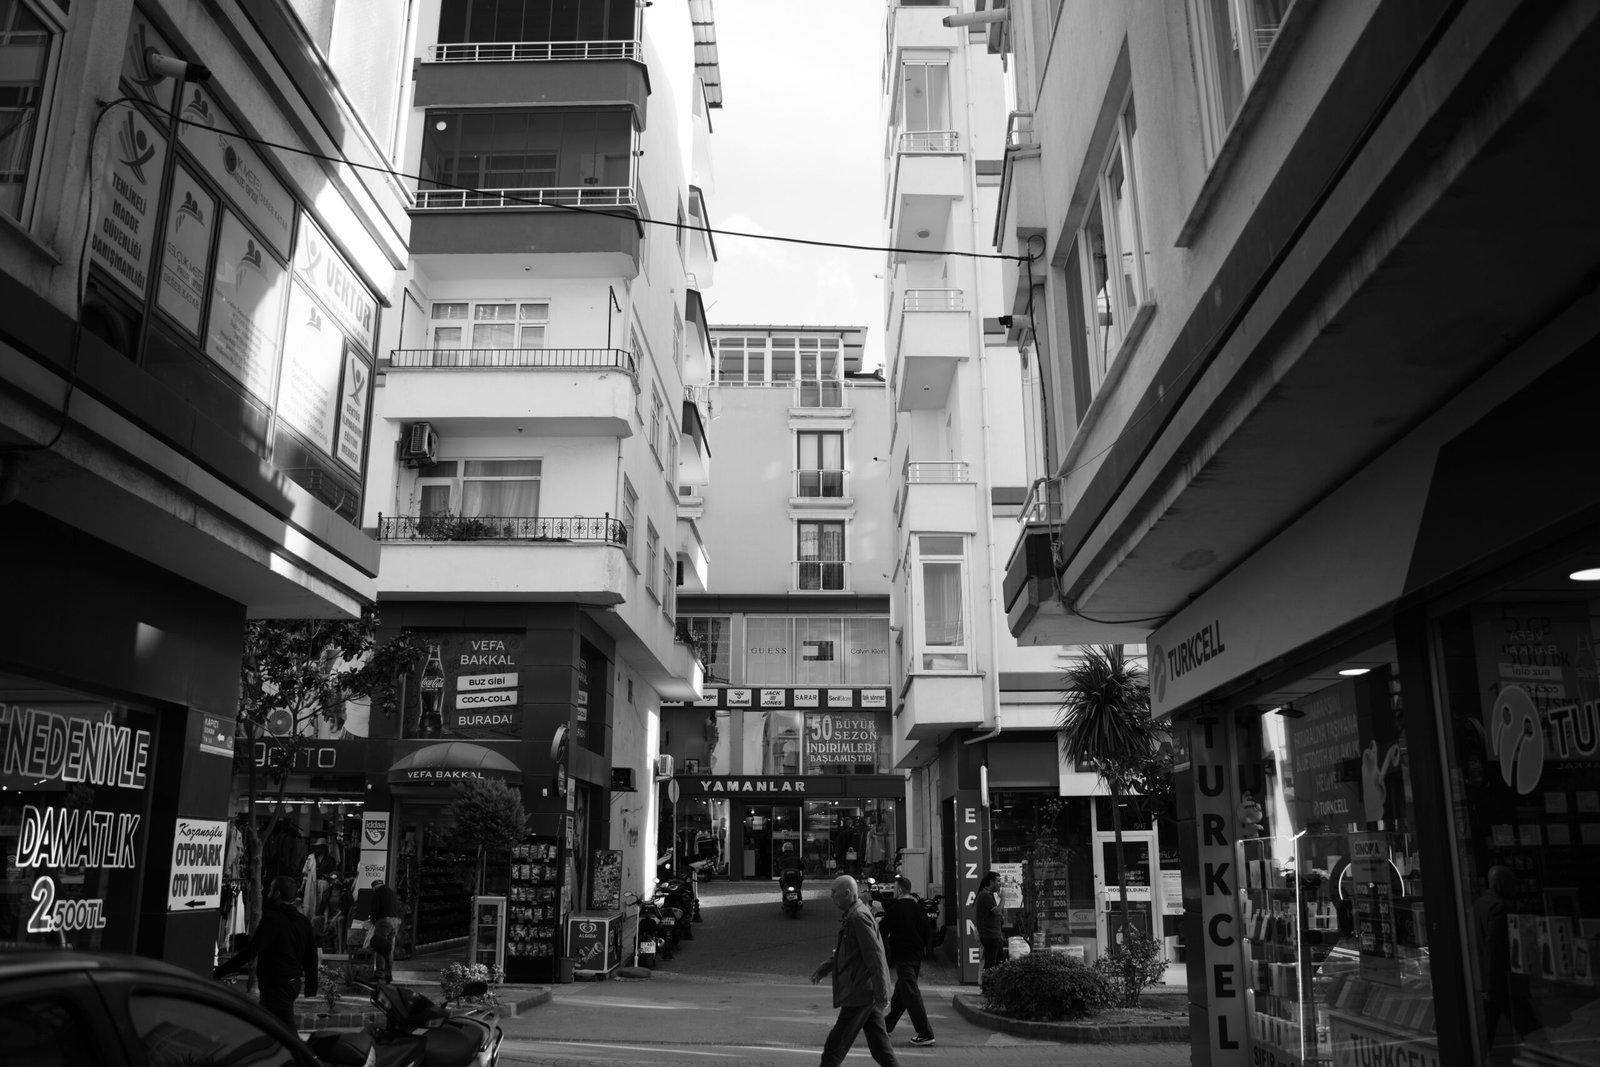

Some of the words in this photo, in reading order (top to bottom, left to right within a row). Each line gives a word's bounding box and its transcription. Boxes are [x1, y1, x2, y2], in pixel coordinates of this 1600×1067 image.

[112, 171, 146, 216] TEHLİKELİ
[112, 199, 140, 235] MADDE
[103, 217, 142, 262] GÜVENLİĞİ
[92, 233, 146, 291] DANIŞMANLIĞI
[326, 257, 371, 333] VEKTÖR
[472, 640, 505, 651] VEFA
[750, 647, 787, 655] GUESS
[1167, 619, 1225, 681] TURKCELL
[460, 654, 515, 665] BAKKAL
[469, 678, 486, 686] BUZ
[488, 676, 506, 686] GİBİ
[462, 695, 511, 704] COCA-COLA
[458, 714, 513, 726] BURADA!
[811, 715, 832, 740] 50
[835, 719, 876, 729] BÜYÜK
[834, 731, 877, 740] SEZON
[4, 705, 151, 789] NEDENİYLE
[807, 741, 876, 754] İNDİRİMLERİ
[810, 754, 872, 763] BAŞLAMIŞTIR
[407, 771, 432, 779] VEFA
[436, 771, 485, 779] BAKKAL
[701, 780, 806, 793] YAMANLAR
[1319, 798, 1349, 816] TURKCELL
[16, 804, 141, 868] DAMATLIK
[178, 822, 224, 842] Kozanoğlu
[175, 843, 222, 867] OTOPARK
[172, 873, 189, 897] OTO
[191, 873, 219, 895] YIKAMA
